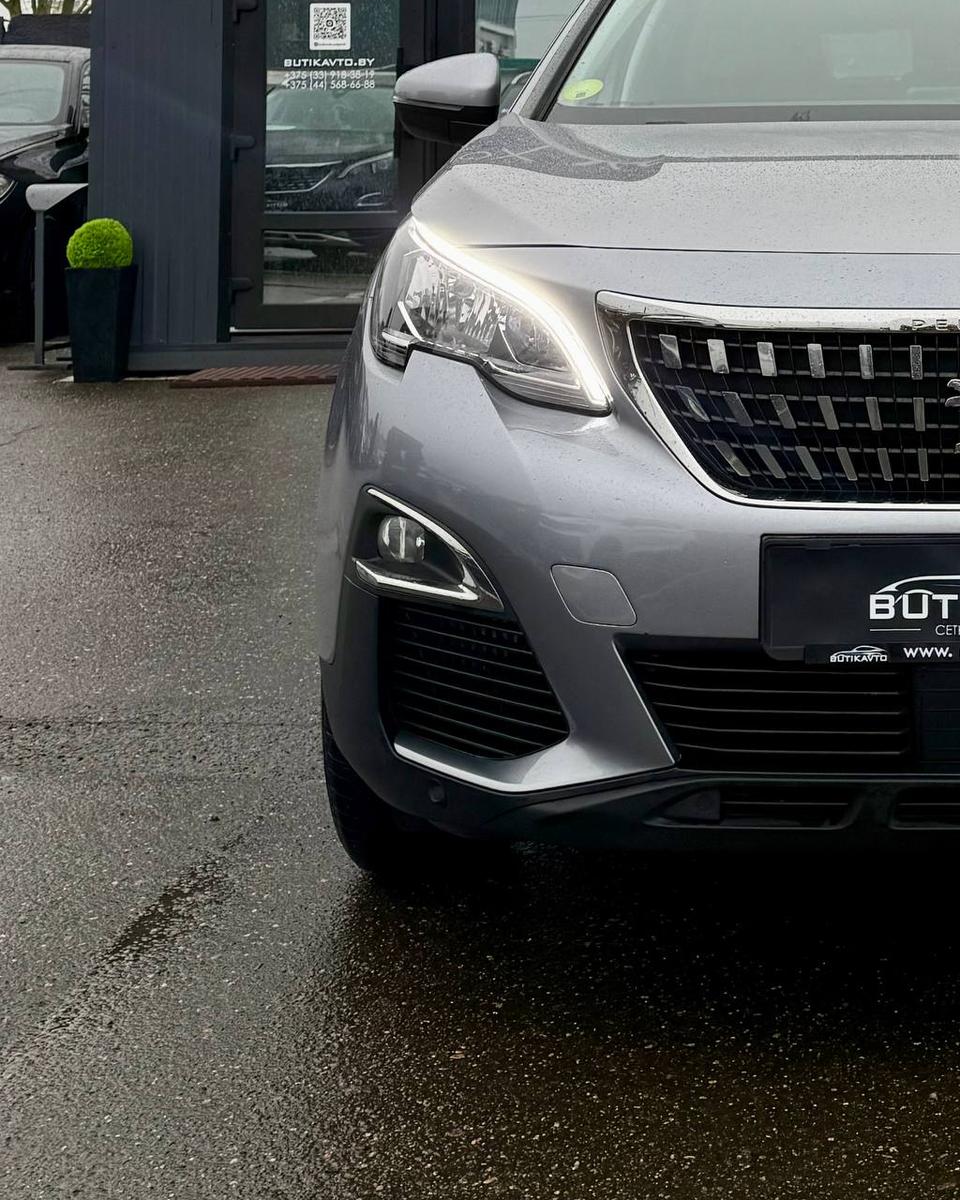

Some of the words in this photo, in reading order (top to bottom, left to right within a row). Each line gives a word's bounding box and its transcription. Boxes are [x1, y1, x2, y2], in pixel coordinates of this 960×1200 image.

[284, 58, 375, 67] BUTIKAVTO.BY
[310, 70, 327, 80] (33)
[310, 80, 327, 90] (44)
[330, 80, 375, 89] 568-66-88
[830, 653, 888, 663] BUTIKAVTO
